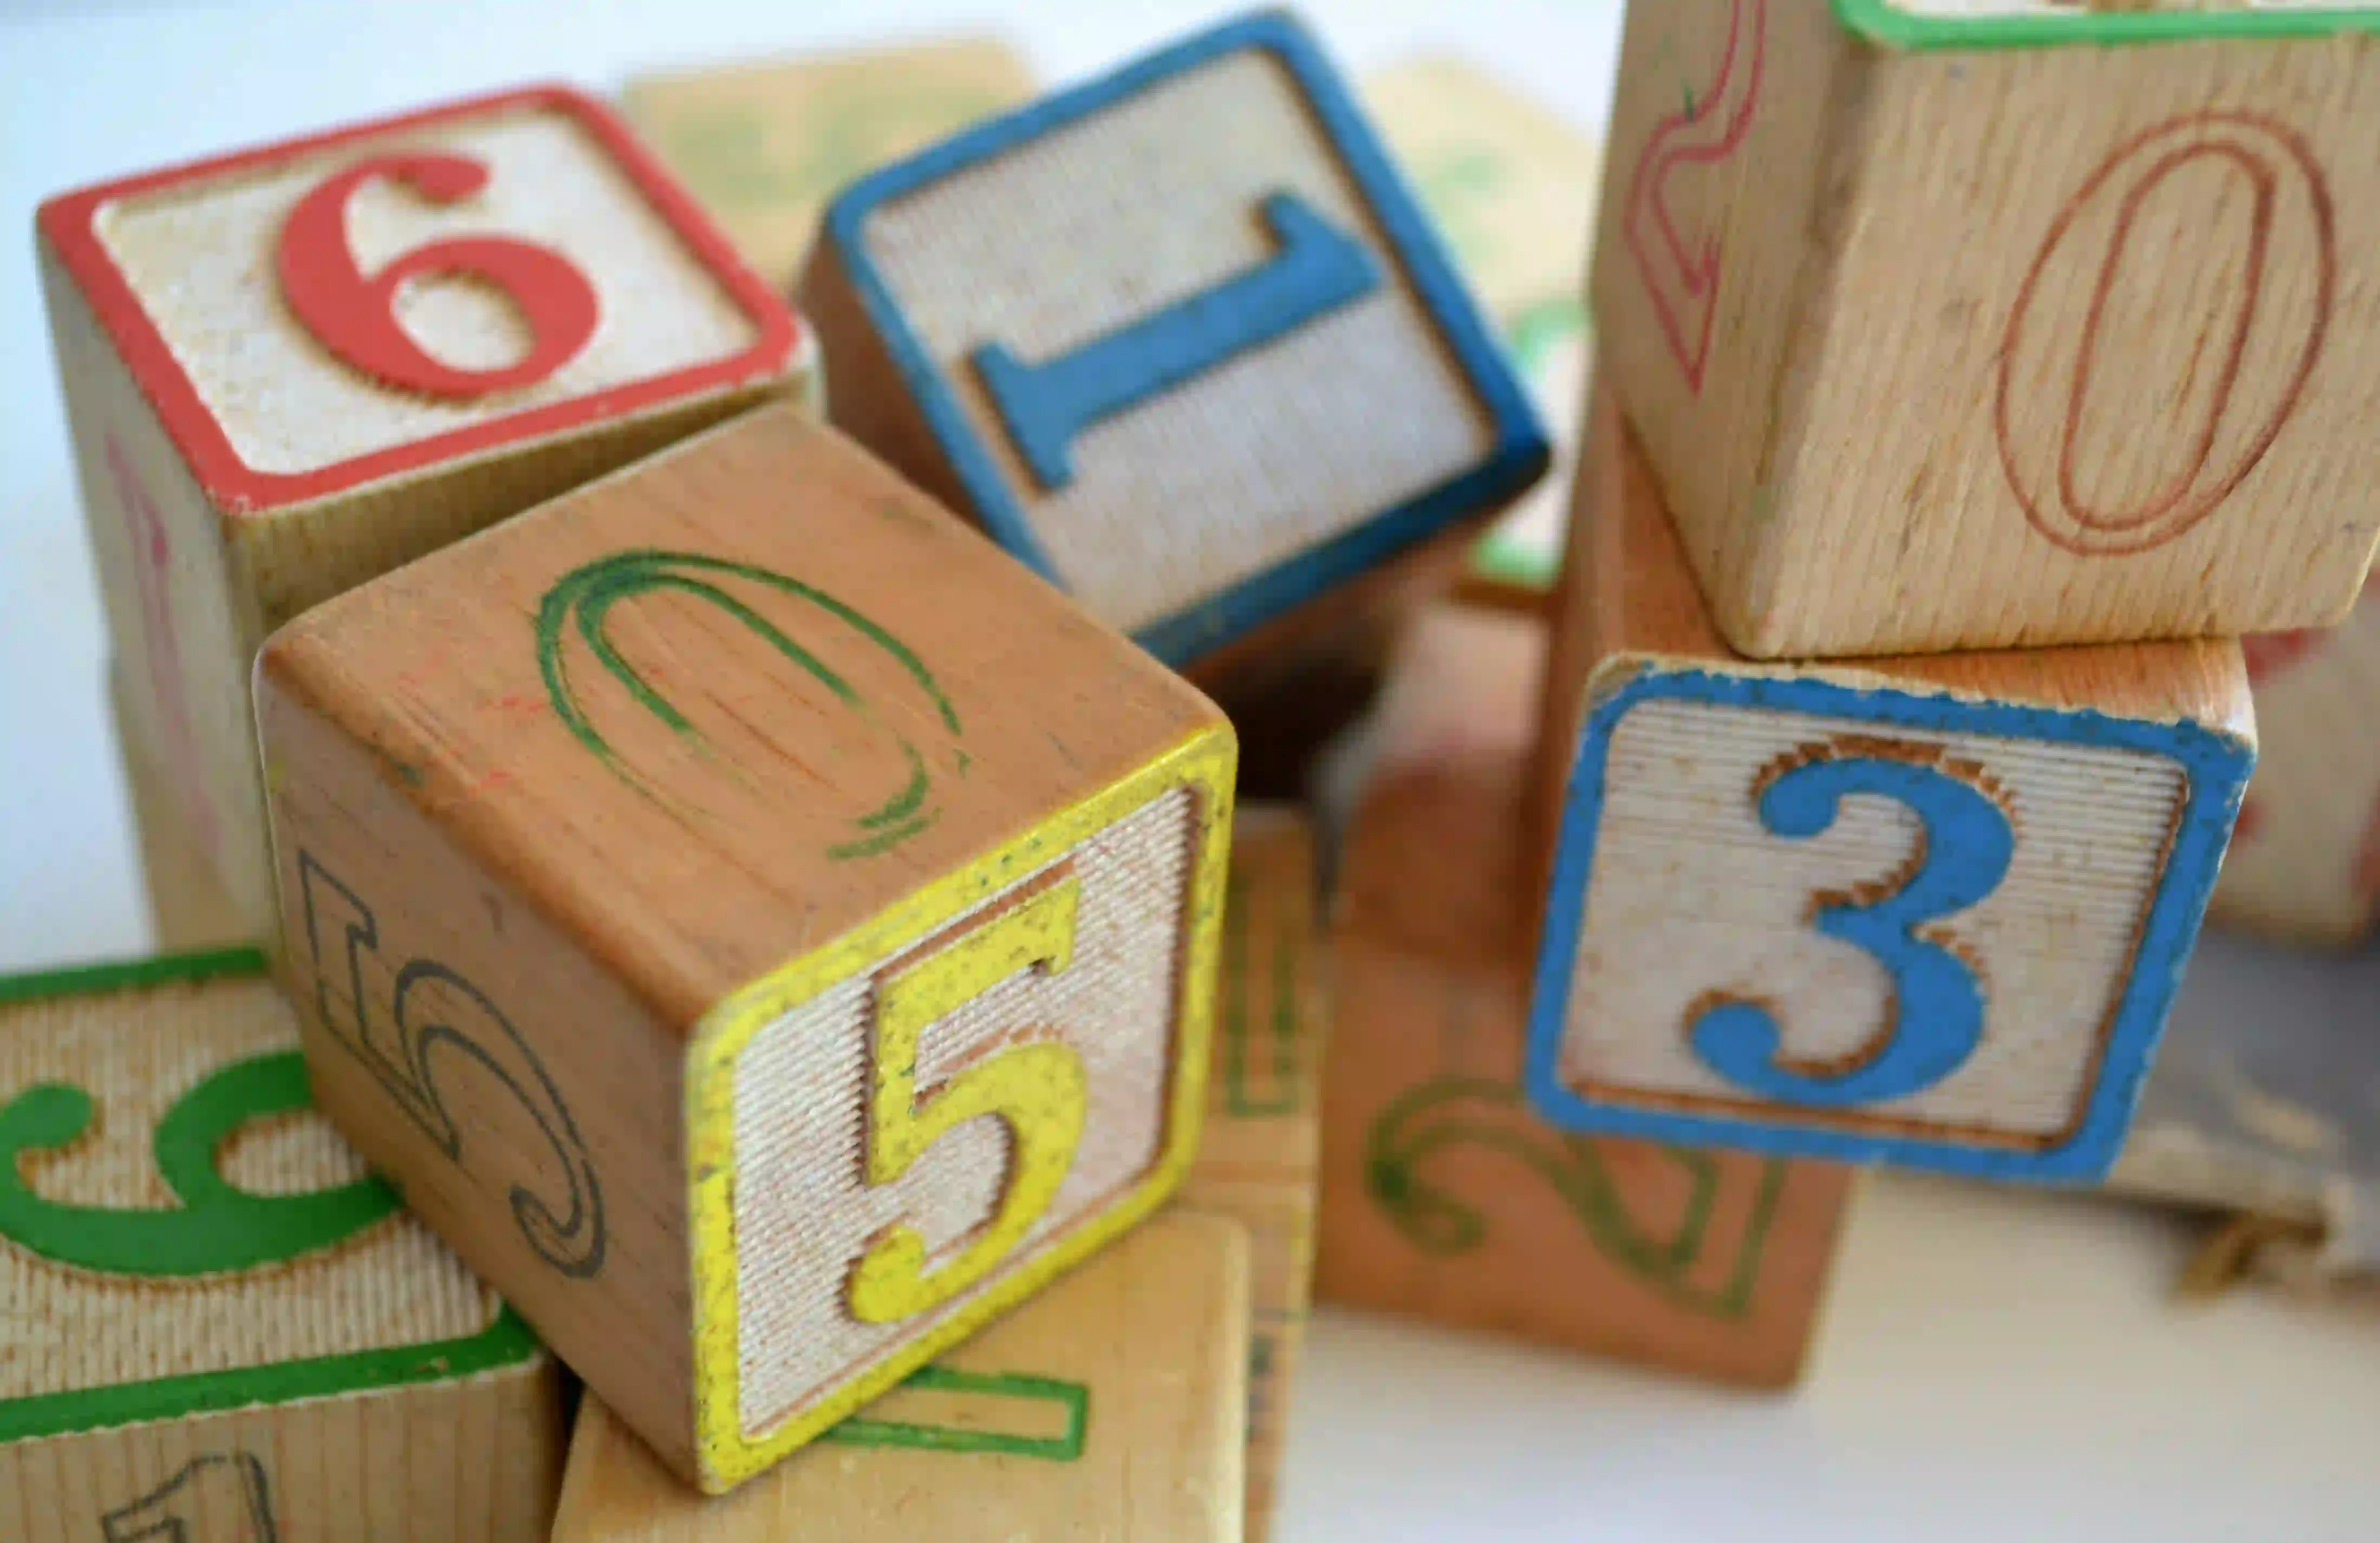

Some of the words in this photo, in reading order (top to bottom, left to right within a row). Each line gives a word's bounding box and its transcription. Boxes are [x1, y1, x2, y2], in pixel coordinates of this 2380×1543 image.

[974, 187, 1382, 491] 1
[1994, 109, 2336, 559] 0
[298, 848, 606, 1279] 5
[844, 877, 1088, 1324] 5
[1688, 757, 2015, 1108] 3
